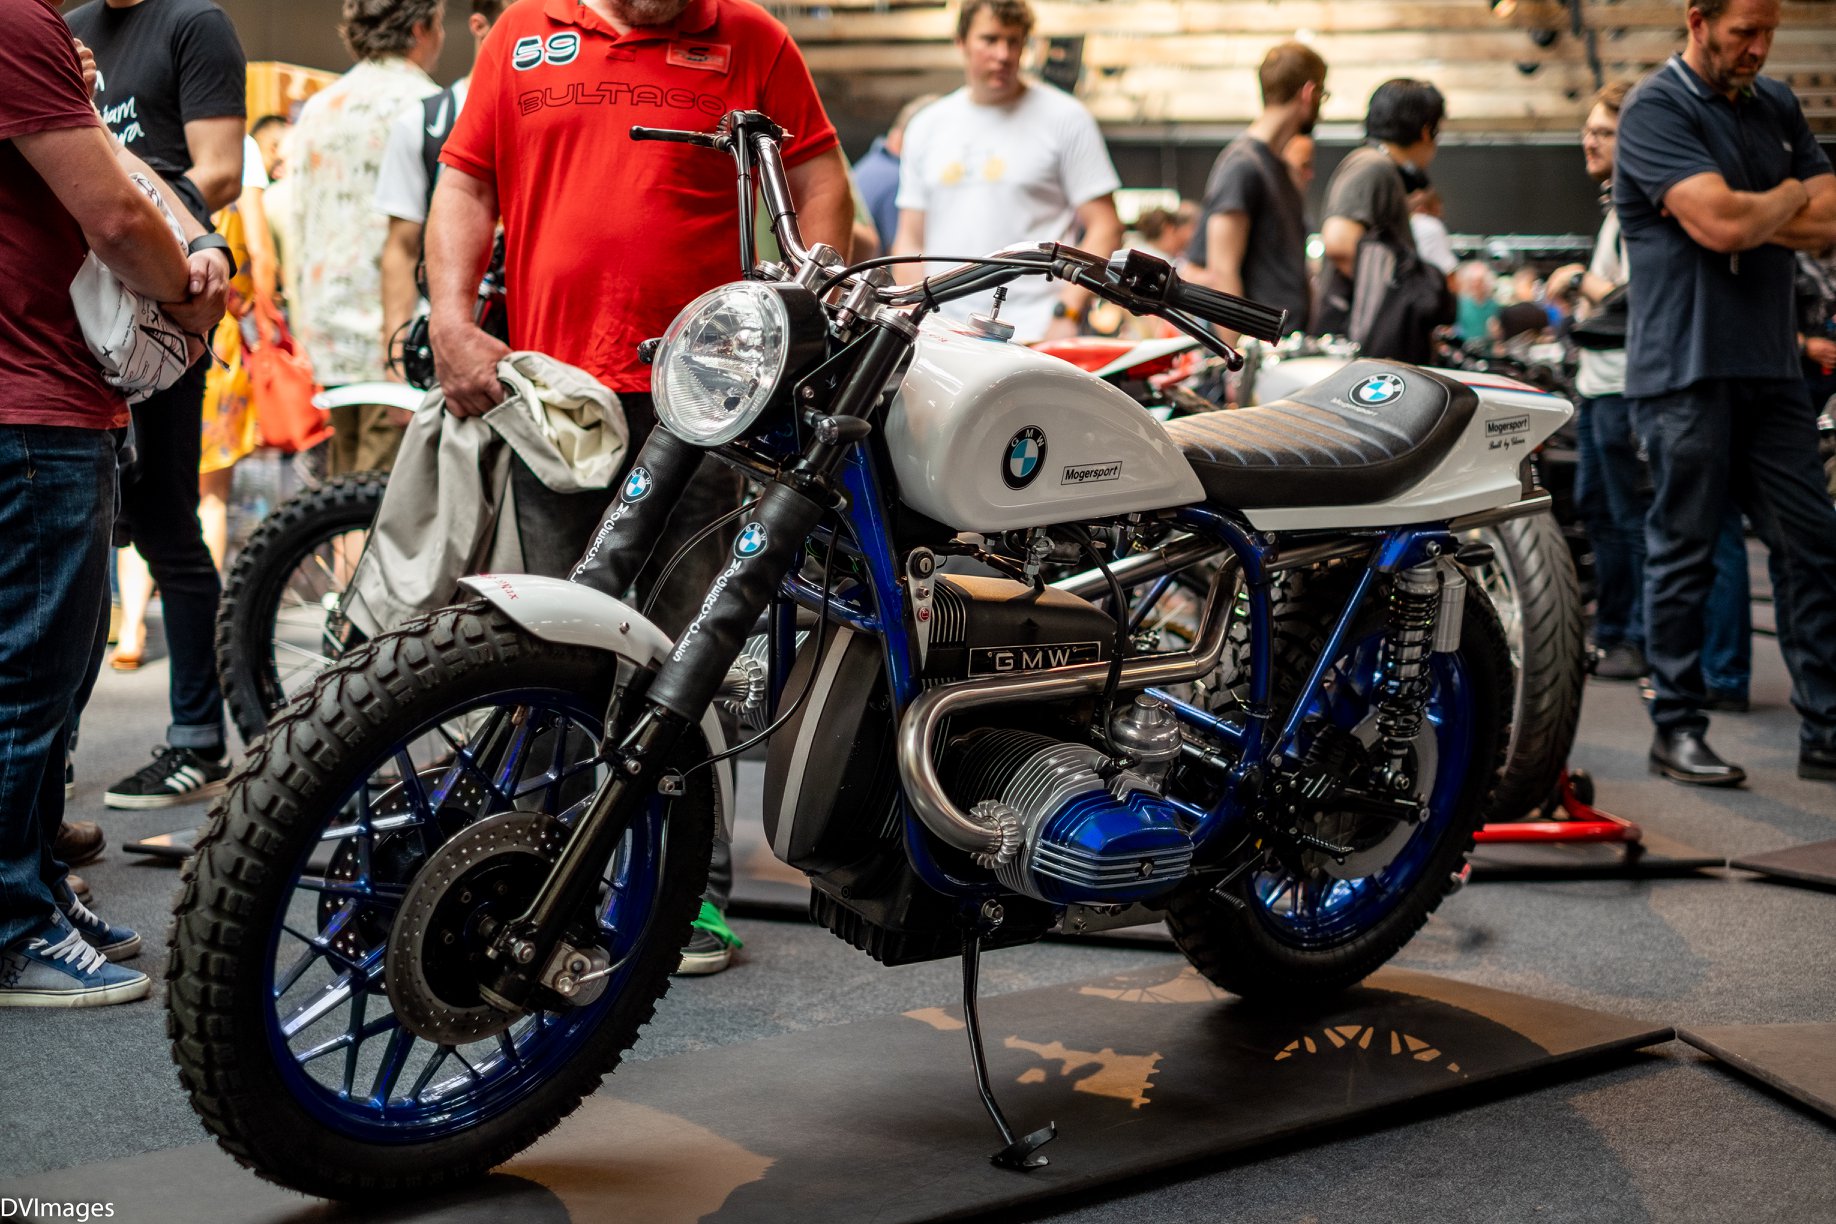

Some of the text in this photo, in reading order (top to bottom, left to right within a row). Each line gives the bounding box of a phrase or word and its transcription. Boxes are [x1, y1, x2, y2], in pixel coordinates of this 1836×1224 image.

[512, 31, 581, 71] 59
[517, 82, 727, 117] BULTACO
[1487, 418, 1528, 434] Mogersport
[1064, 465, 1119, 481] Mogersport
[569, 503, 630, 584] MOGERCYCL
[672, 558, 742, 662] MOGERCYCLES
[995, 649, 1071, 671] GMW
